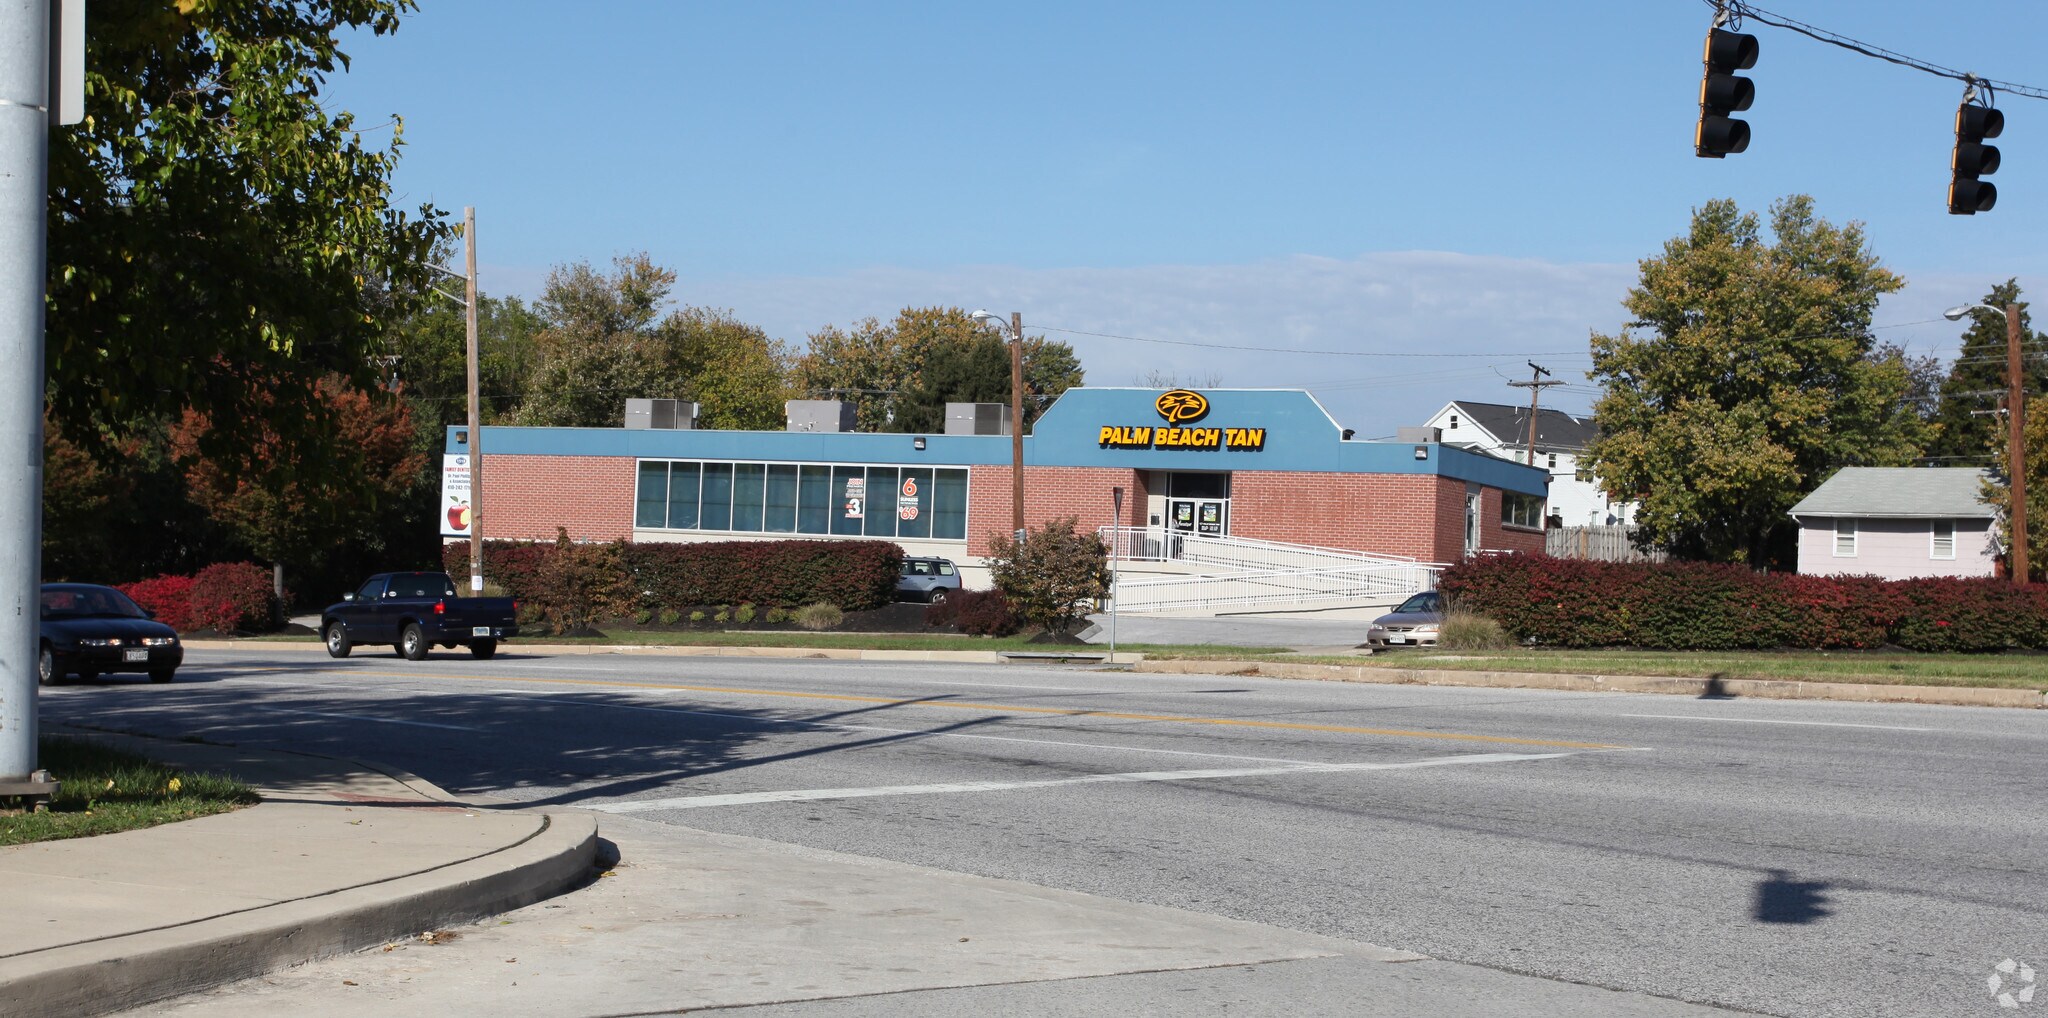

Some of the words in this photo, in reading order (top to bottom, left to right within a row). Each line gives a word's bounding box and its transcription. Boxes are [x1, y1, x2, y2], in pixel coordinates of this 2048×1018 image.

[1098, 426, 1152, 447] PALM
[1153, 427, 1221, 449] BEACH
[1225, 428, 1264, 450] TAN
[903, 478, 917, 496] 6
[848, 498, 861, 515] 3
